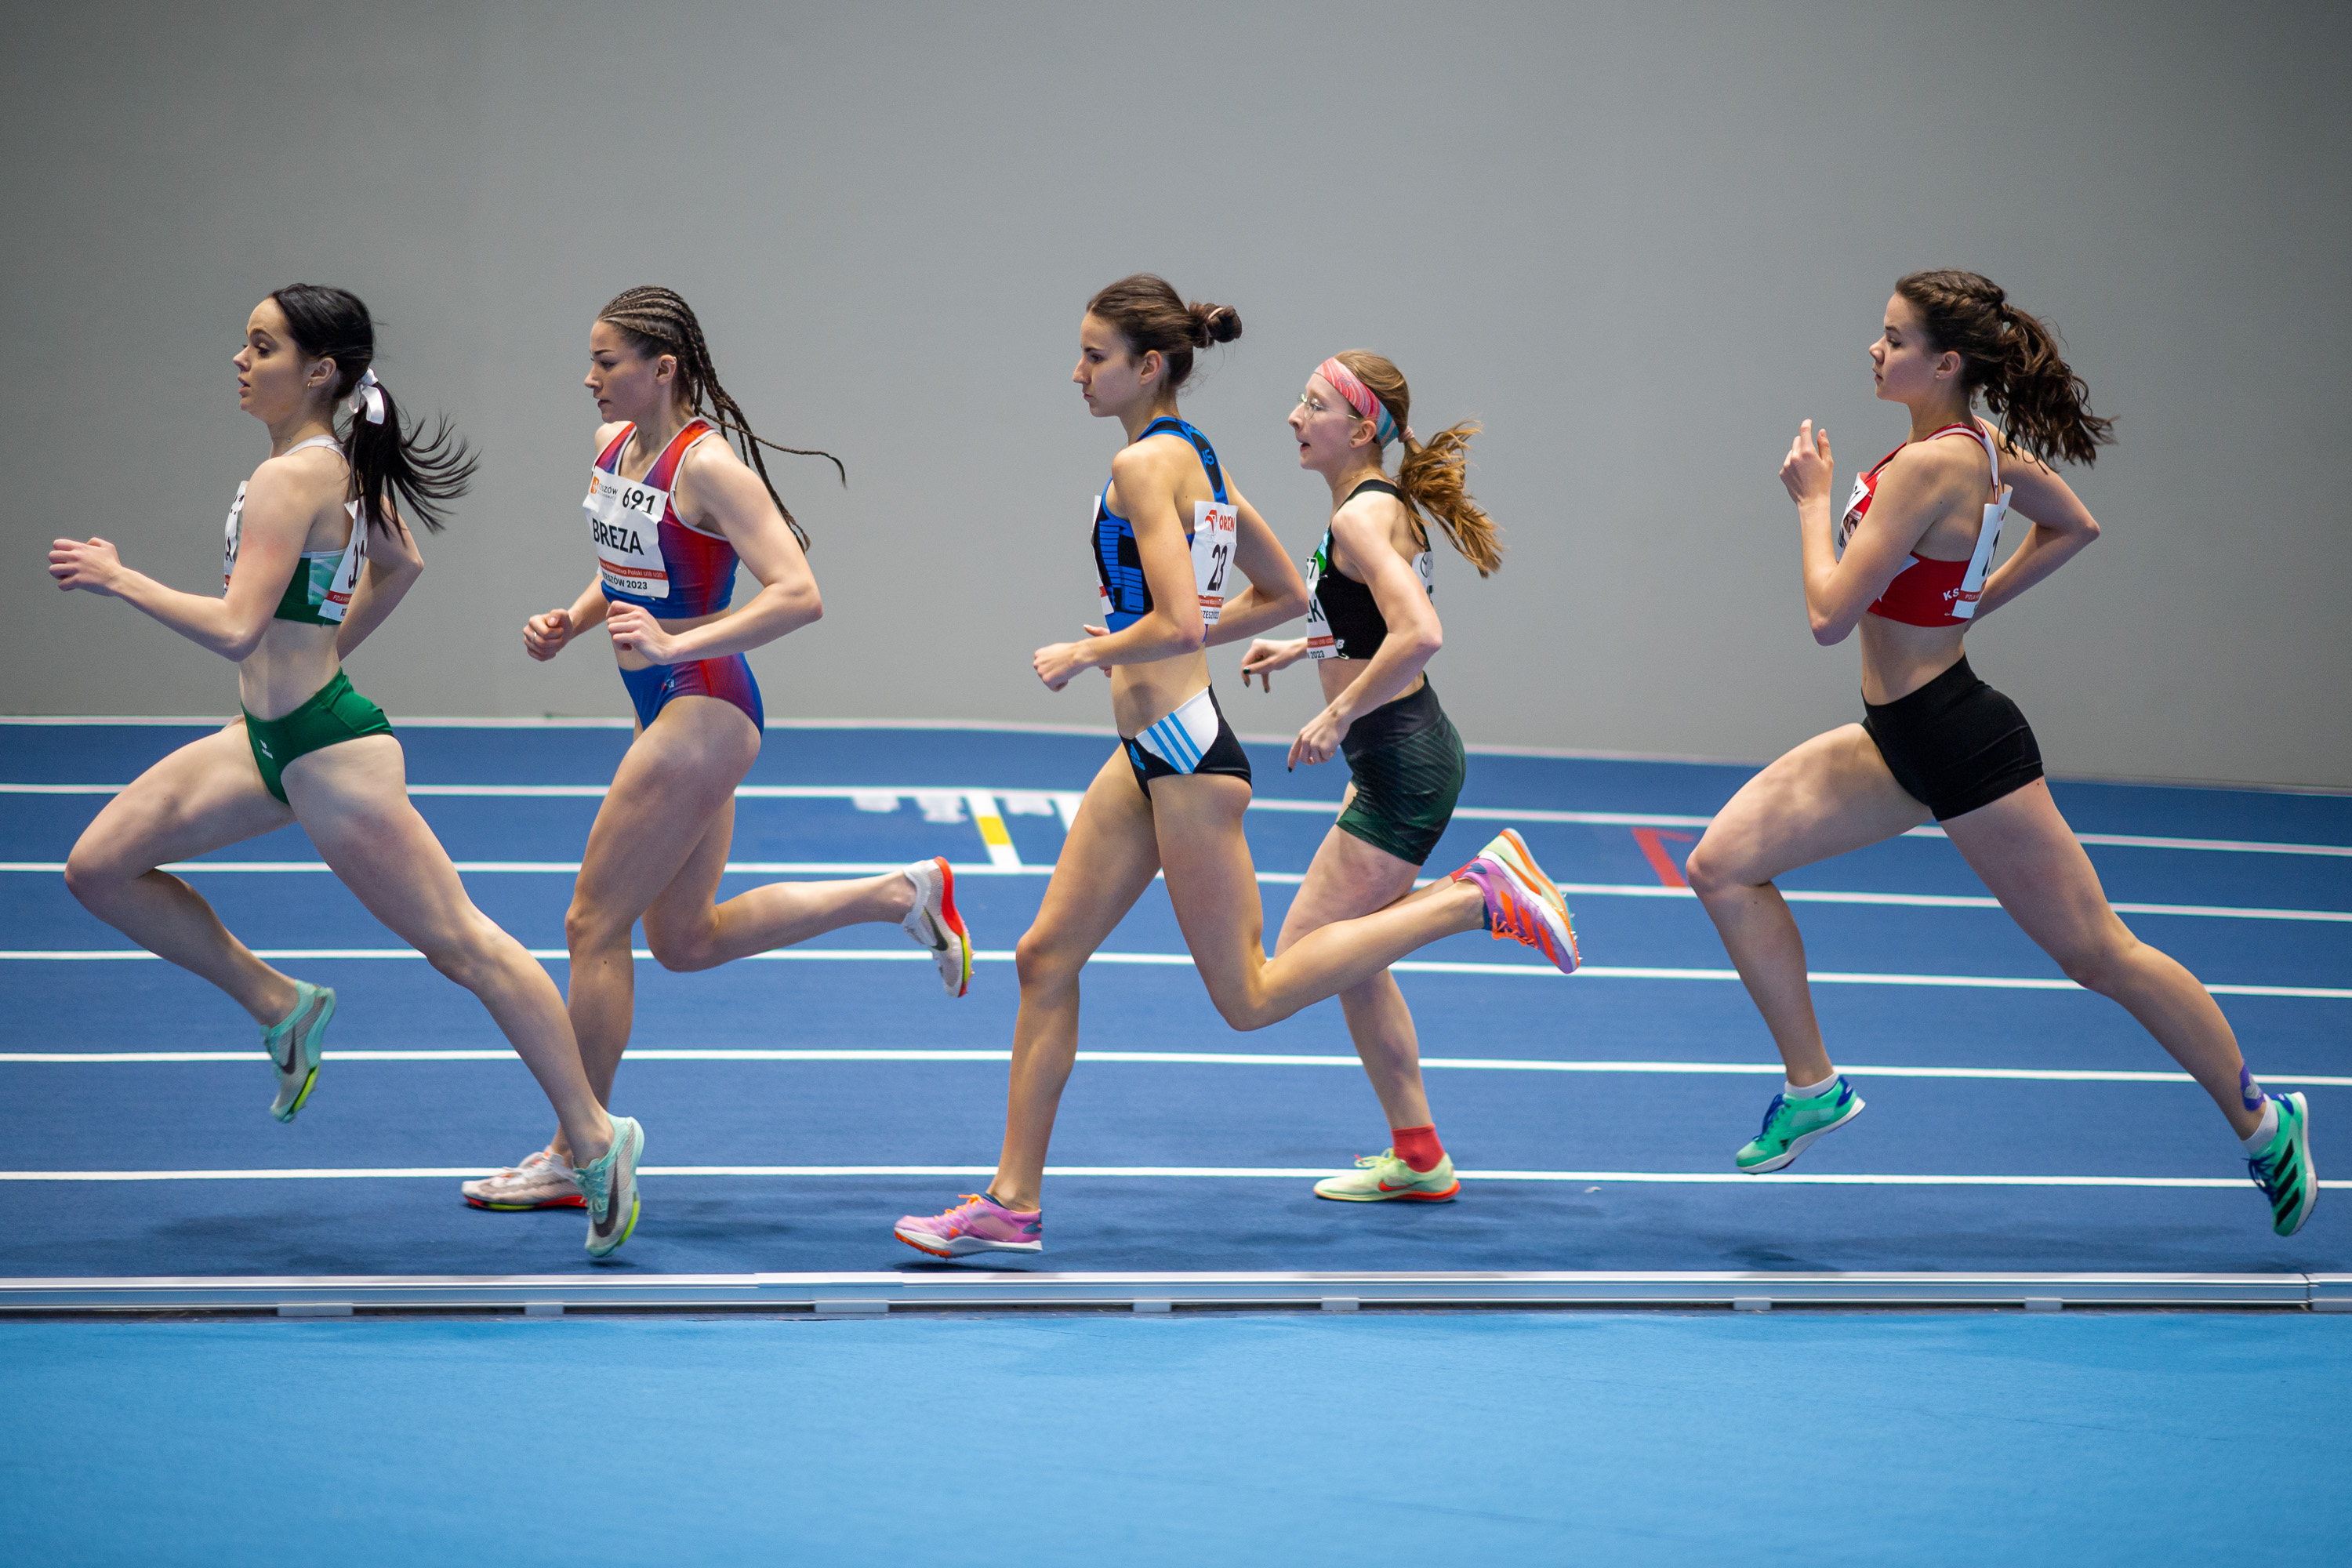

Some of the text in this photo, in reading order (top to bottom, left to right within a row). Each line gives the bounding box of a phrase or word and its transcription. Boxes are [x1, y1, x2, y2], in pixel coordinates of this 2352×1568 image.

[622, 487, 656, 515] 691
[592, 517, 644, 556] BREZA
[1207, 543, 1228, 592] 23
[626, 580, 648, 590] 2023
[1310, 650, 1325, 659] 2023
